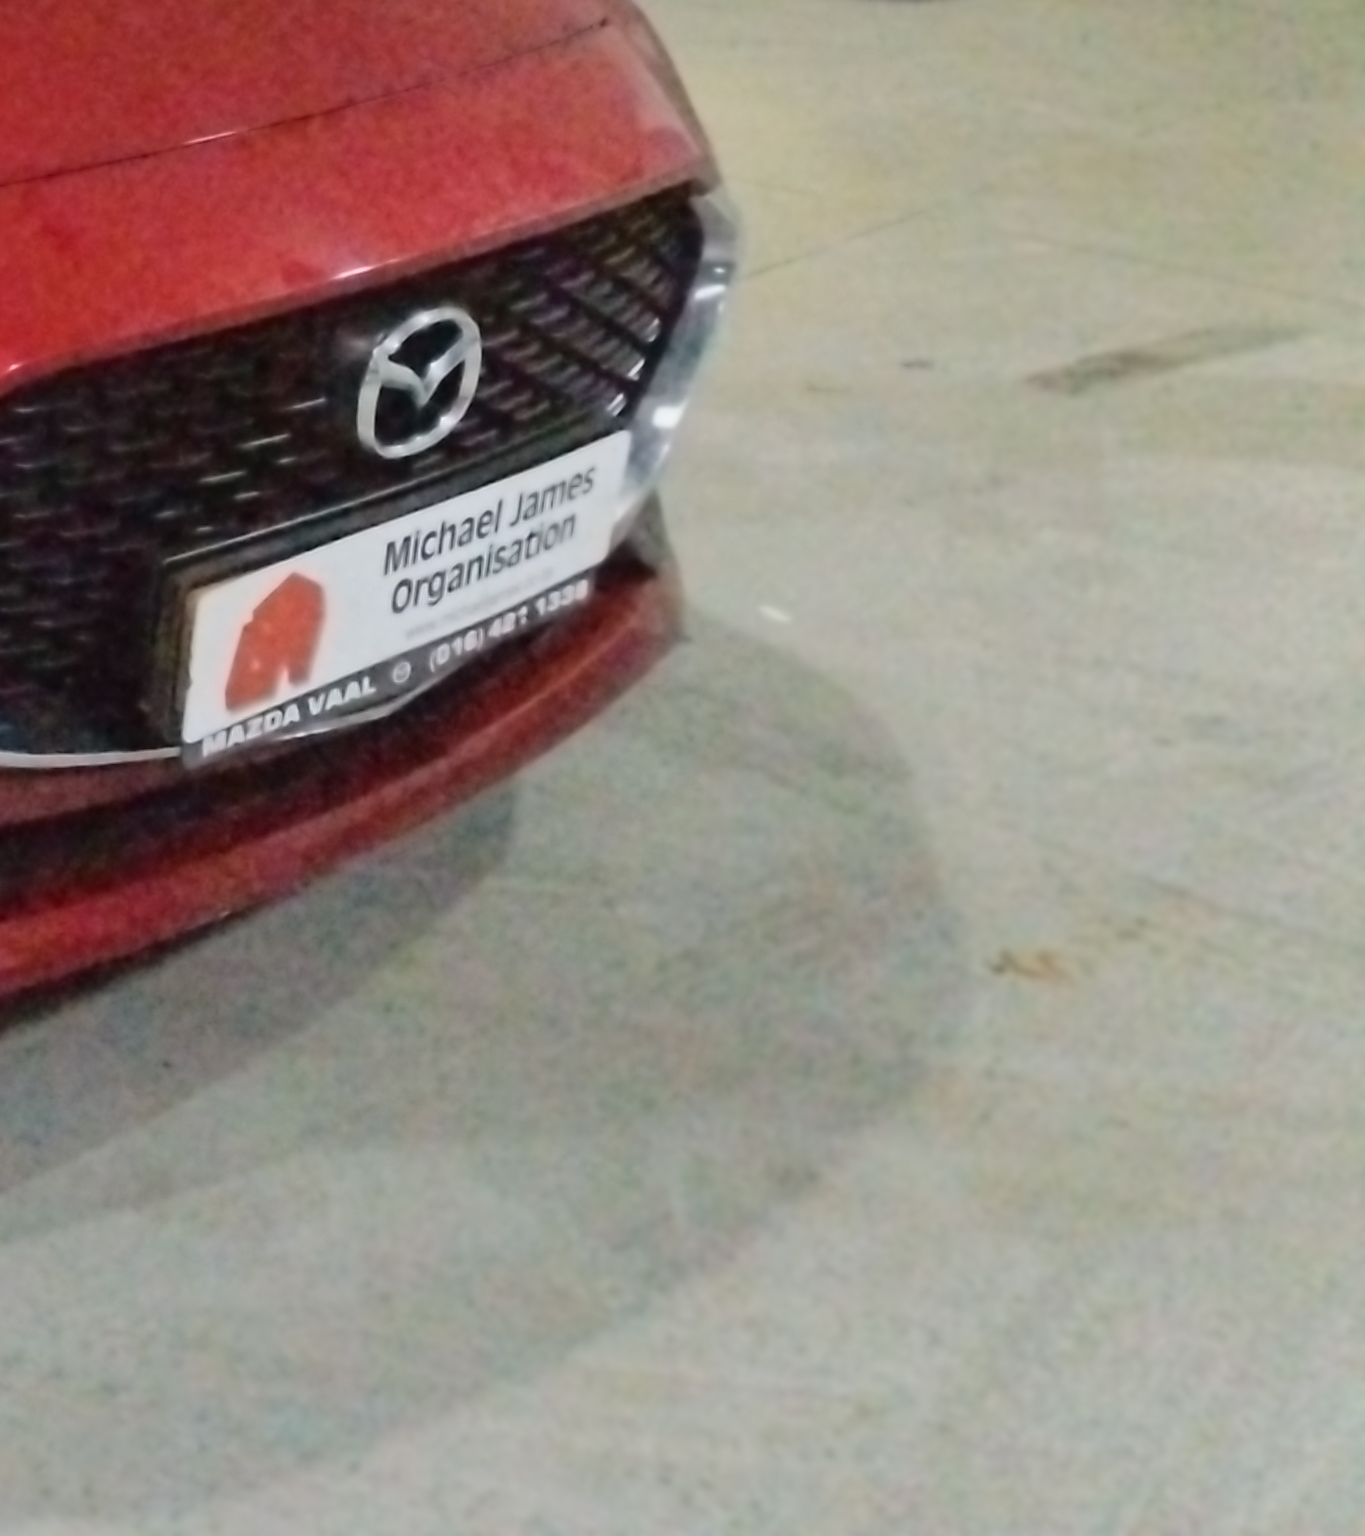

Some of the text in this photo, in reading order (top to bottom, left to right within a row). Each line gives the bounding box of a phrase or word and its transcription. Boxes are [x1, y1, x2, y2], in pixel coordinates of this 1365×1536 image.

[383, 466, 597, 576] Michael James
[390, 512, 577, 615] Organisation
[202, 700, 300, 758] MAZDA
[307, 676, 377, 718] VAAL
